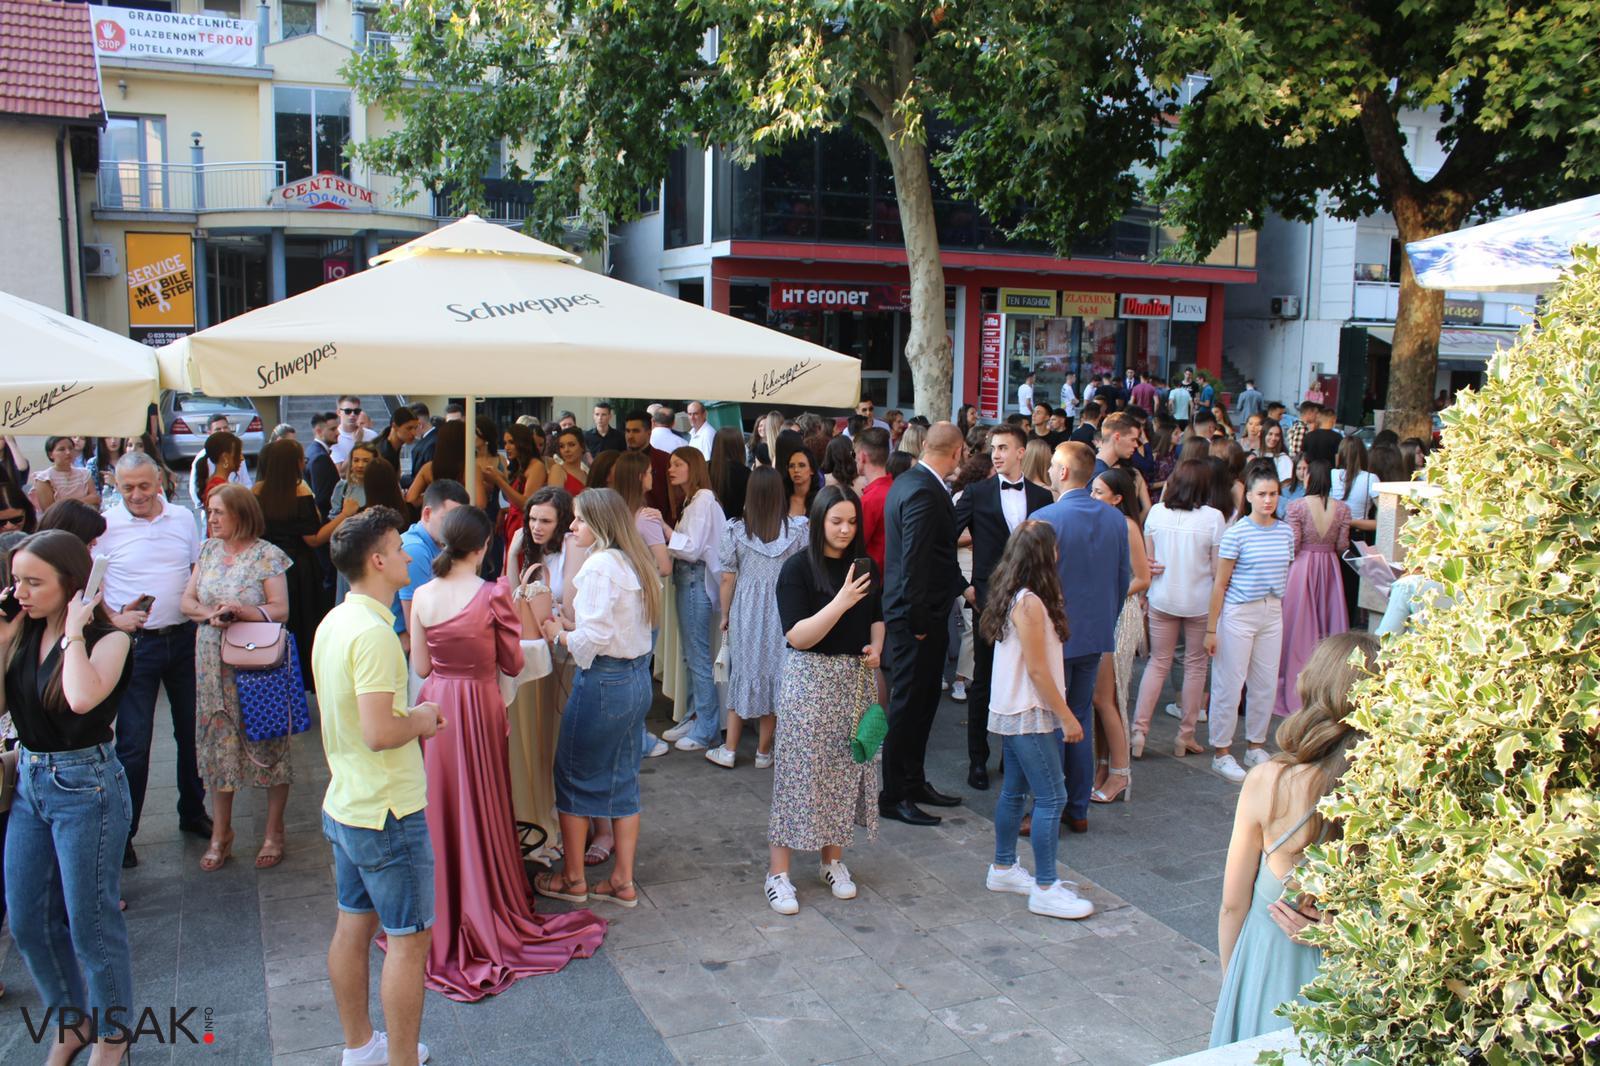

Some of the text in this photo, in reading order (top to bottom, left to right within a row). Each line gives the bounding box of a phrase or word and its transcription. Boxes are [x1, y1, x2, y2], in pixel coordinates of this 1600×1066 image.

[98, 39, 121, 49] STOP
[129, 28, 253, 47] GLAZBENOM TERORU
[129, 43, 205, 57] HOTELA PARK
[282, 177, 373, 204] CENTRUM
[127, 255, 184, 284] SERVICE
[782, 289, 805, 303] HT
[1007, 296, 1051, 307] TEN FASHION
[1065, 294, 1113, 304] ZLATARNA
[446, 293, 600, 323] Schweppes
[257, 341, 337, 389] Schweppes
